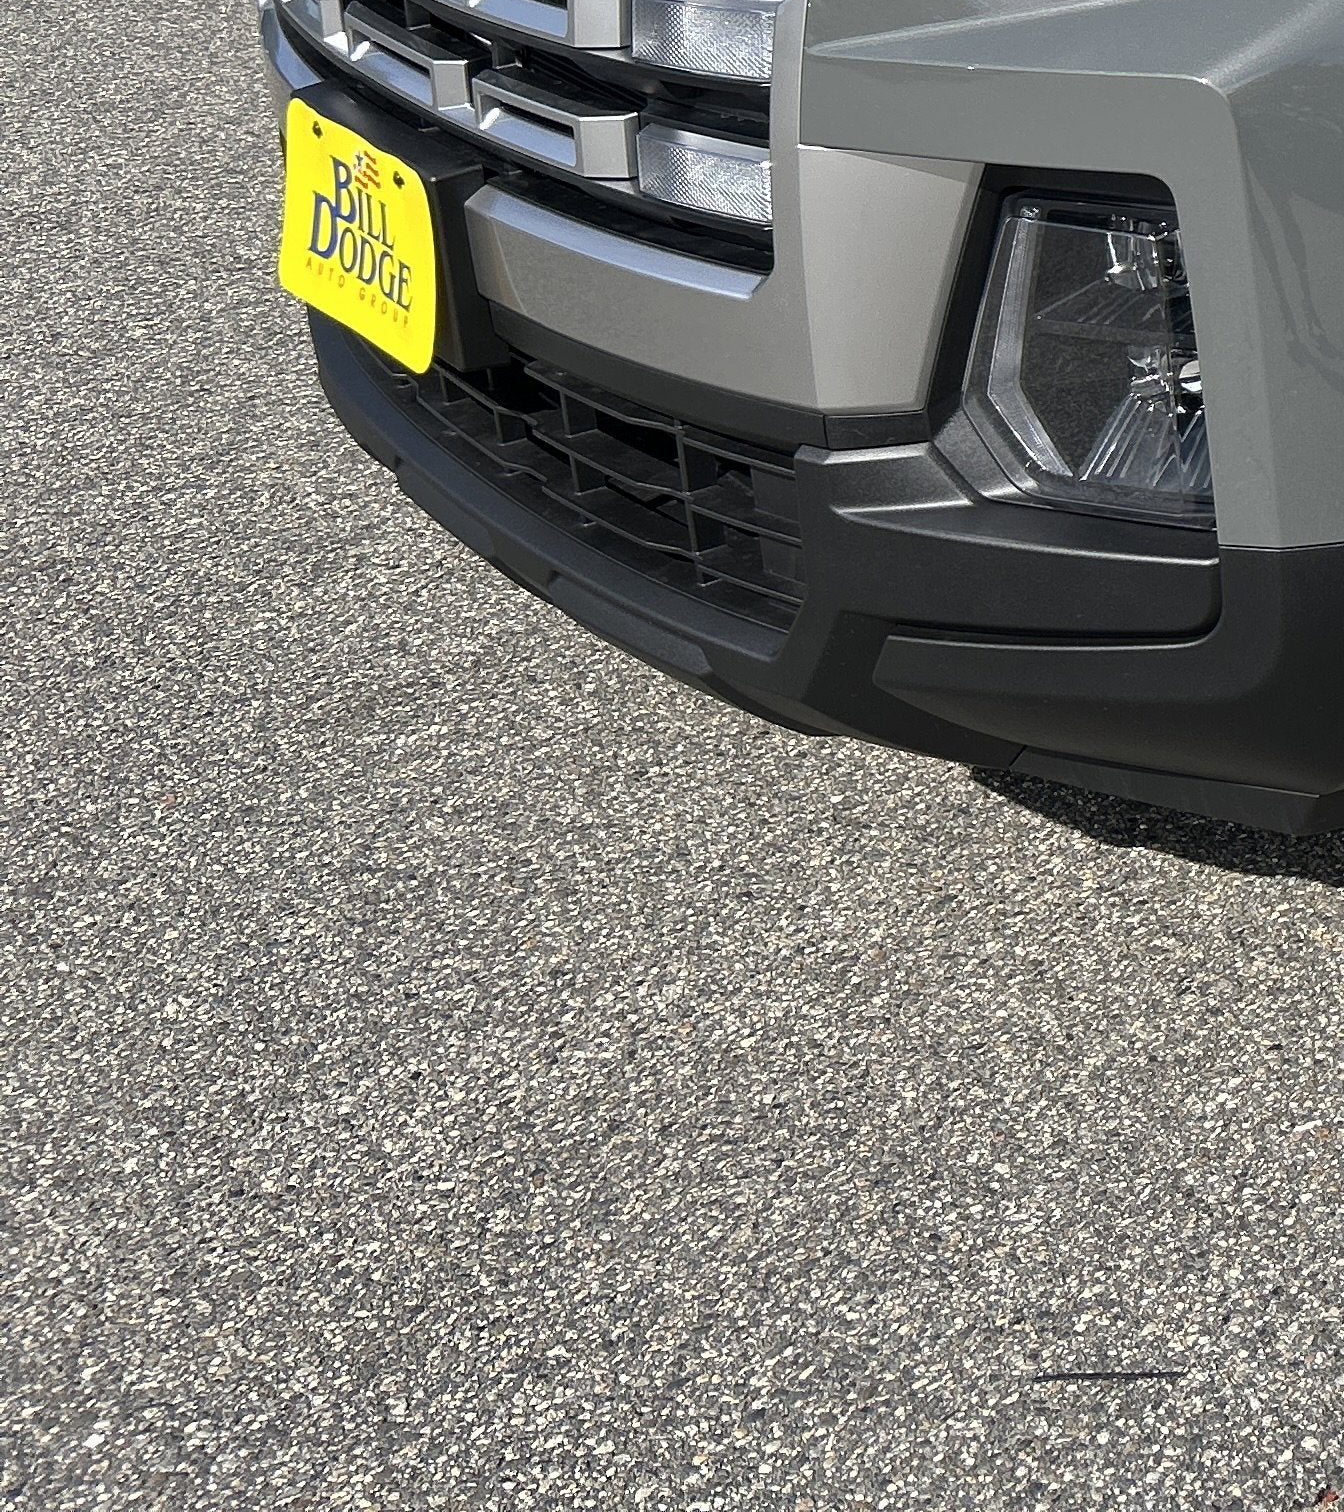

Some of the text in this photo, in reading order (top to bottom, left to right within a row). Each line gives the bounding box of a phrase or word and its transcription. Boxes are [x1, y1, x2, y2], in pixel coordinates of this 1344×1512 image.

[330, 155, 394, 250] BILL
[305, 256, 410, 329] AUTO GROUP
[308, 190, 413, 313] DODGE
